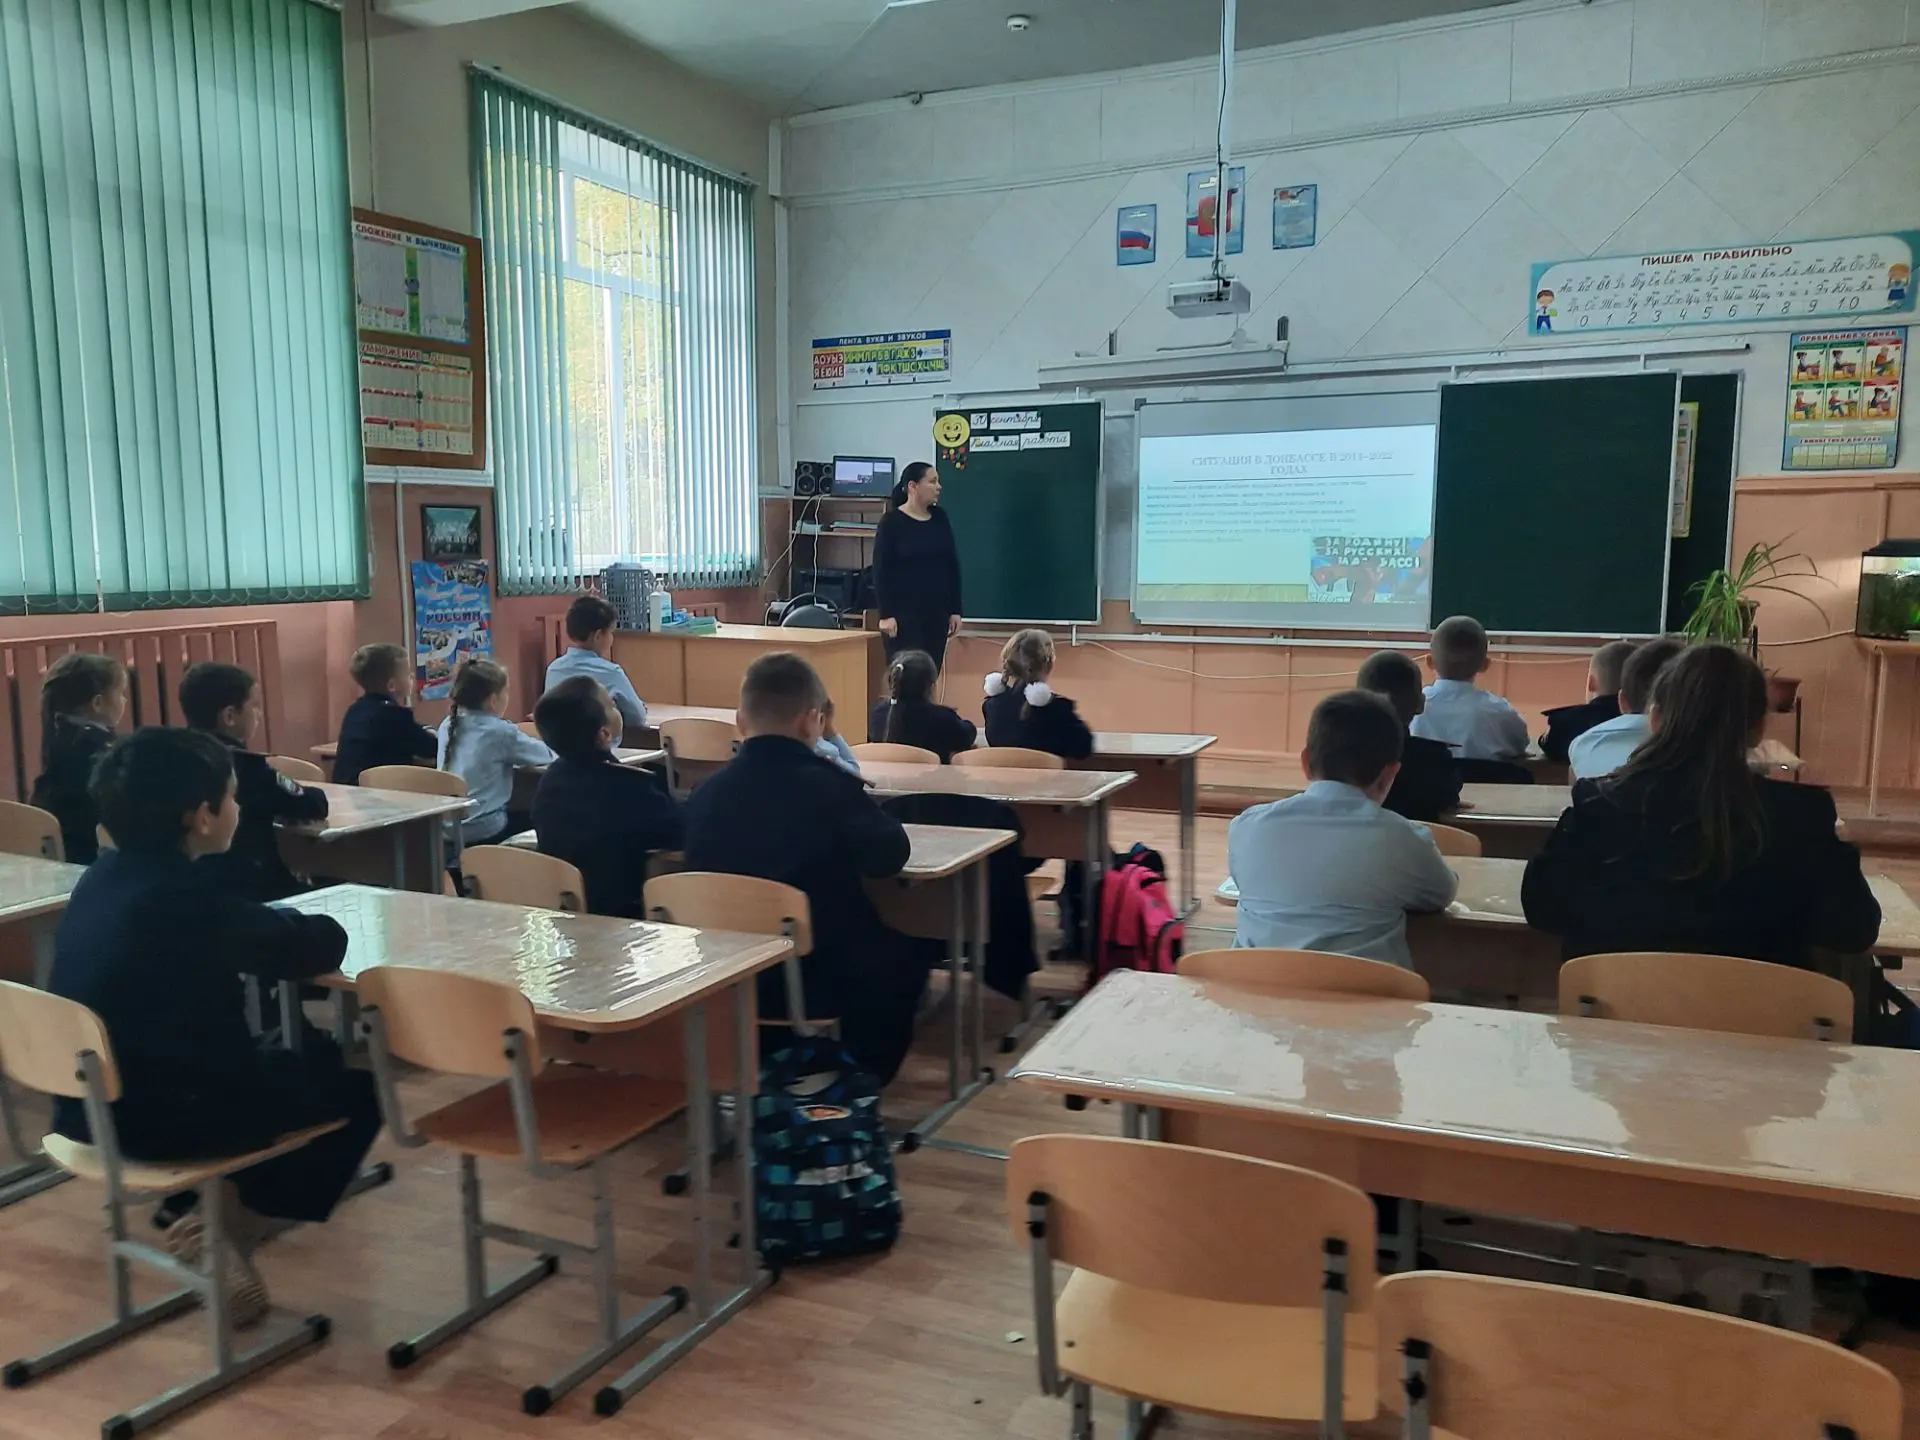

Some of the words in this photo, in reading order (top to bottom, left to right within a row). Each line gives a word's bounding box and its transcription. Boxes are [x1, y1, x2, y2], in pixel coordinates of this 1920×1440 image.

[355, 224, 402, 241] СЛОЖЕНИЕ
[415, 237, 461, 254] ВЫЧИТАНИЕ
[1641, 254, 1694, 266] ПИШЕМ
[1703, 246, 1793, 261] ПРАВИЛЬНО
[1579, 315, 1589, 327] 0
[1607, 311, 1617, 325] 1
[1627, 311, 1638, 324] 2
[1652, 310, 1662, 323] 3
[1679, 308, 1688, 321] 4
[1702, 306, 1713, 319] 5
[1728, 304, 1738, 317] 6
[1755, 302, 1764, 315] 7
[1781, 301, 1792, 314] 8
[1808, 299, 1818, 312] 9
[897, 332, 927, 341] ЗВУКОВ
[1255, 455, 1262, 465] В
[1264, 453, 1326, 465] ДОНБАССЕ
[1329, 452, 1337, 462] В
[1270, 465, 1308, 475] ГОДАХ
[1325, 547, 1340, 556] ЗА
[1344, 547, 1406, 556] РУССКИХ!
